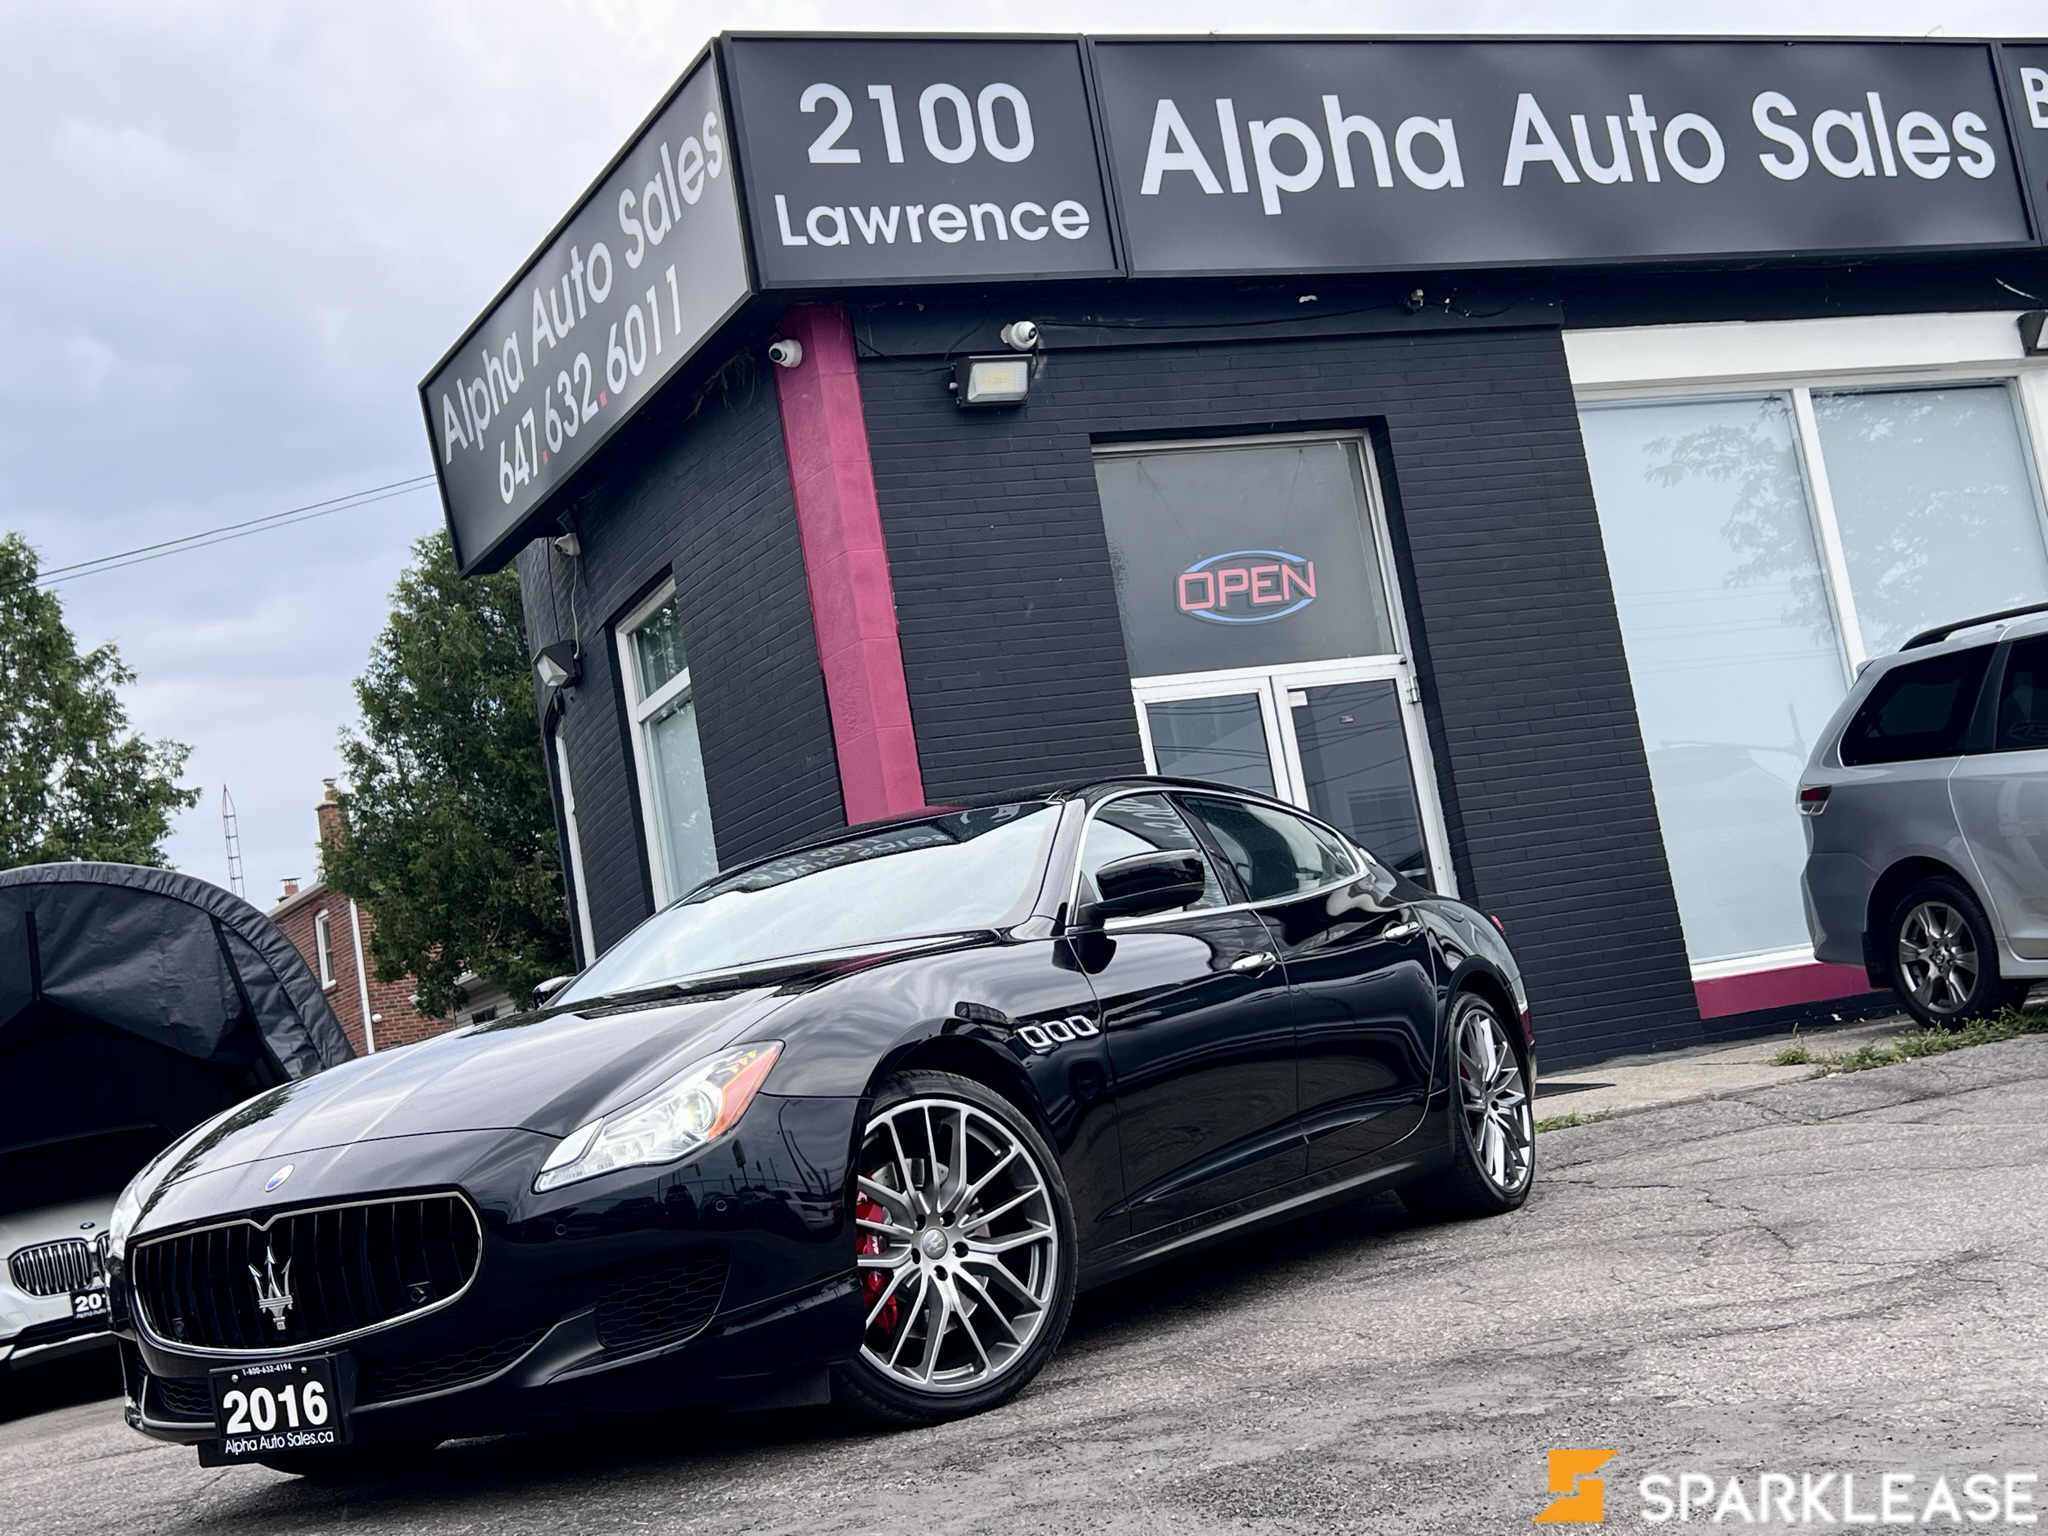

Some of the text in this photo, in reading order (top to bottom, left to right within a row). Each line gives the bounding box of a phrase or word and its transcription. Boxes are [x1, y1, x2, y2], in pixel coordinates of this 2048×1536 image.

[799, 82, 1035, 164] 2100
[1140, 91, 1996, 216] Alpha Auto Sales
[774, 194, 1090, 247] Lawrence
[443, 111, 723, 464] Alpha Auto Sales
[499, 263, 682, 505] 647.632.6011
[1178, 560, 1318, 611] OPEN
[222, 1380, 328, 1435] 2016
[225, 1431, 335, 1455] Alpha Auto Sales.ca
